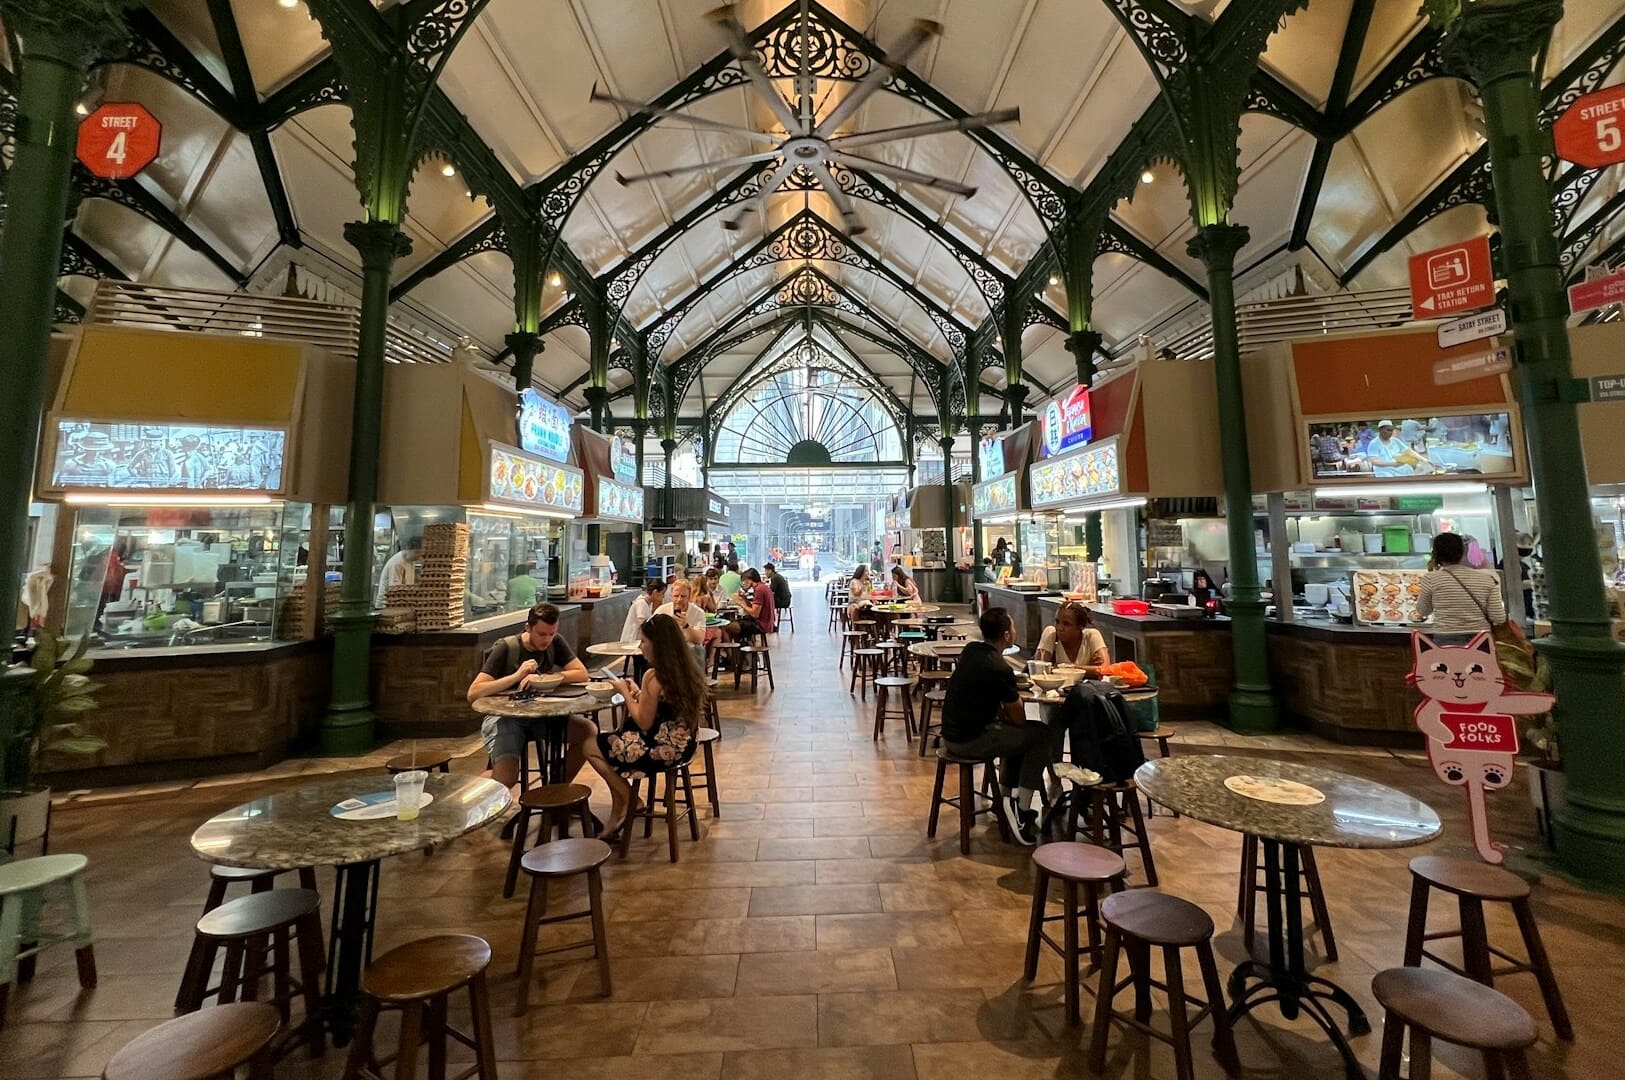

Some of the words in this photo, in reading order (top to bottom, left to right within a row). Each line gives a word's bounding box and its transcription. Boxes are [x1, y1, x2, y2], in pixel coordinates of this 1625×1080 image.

[1580, 98, 1625, 120] STREET
[101, 116, 138, 128] STREET
[1596, 116, 1622, 152] 5
[106, 132, 126, 164] 4
[1436, 291, 1454, 301] TRAY
[1456, 283, 1486, 297] RETURN
[1438, 296, 1468, 310] STATION
[1458, 320, 1476, 332] SATAY
[1477, 313, 1500, 327] STREET
[1459, 722, 1497, 733] FOOD
[1459, 732, 1502, 743] FOLKS
